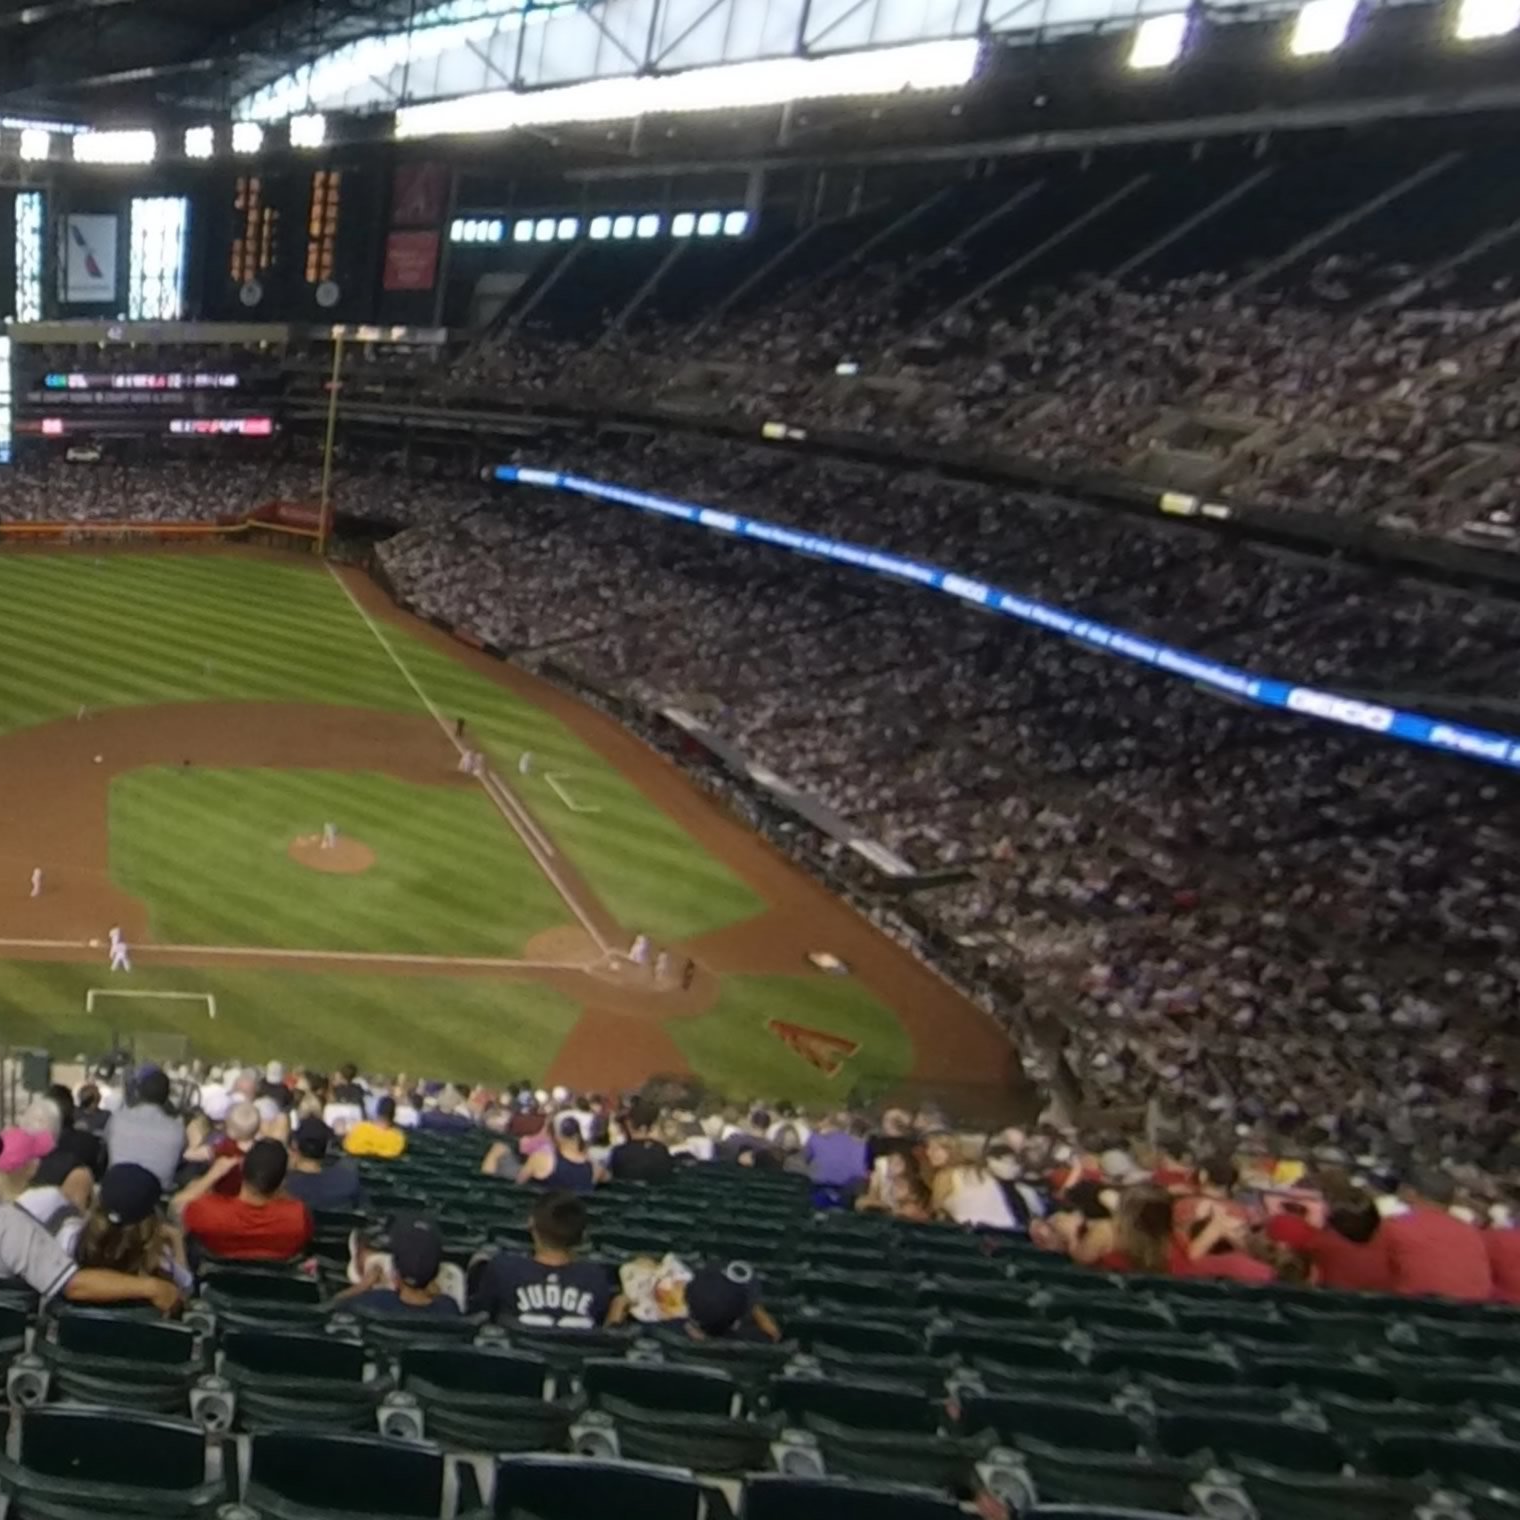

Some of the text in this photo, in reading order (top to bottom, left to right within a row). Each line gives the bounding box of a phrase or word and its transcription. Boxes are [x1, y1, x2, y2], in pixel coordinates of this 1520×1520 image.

[1287, 687, 1394, 732] GEICO
[1430, 724, 1509, 761] Proud
[516, 1283, 594, 1317] JUDGE
